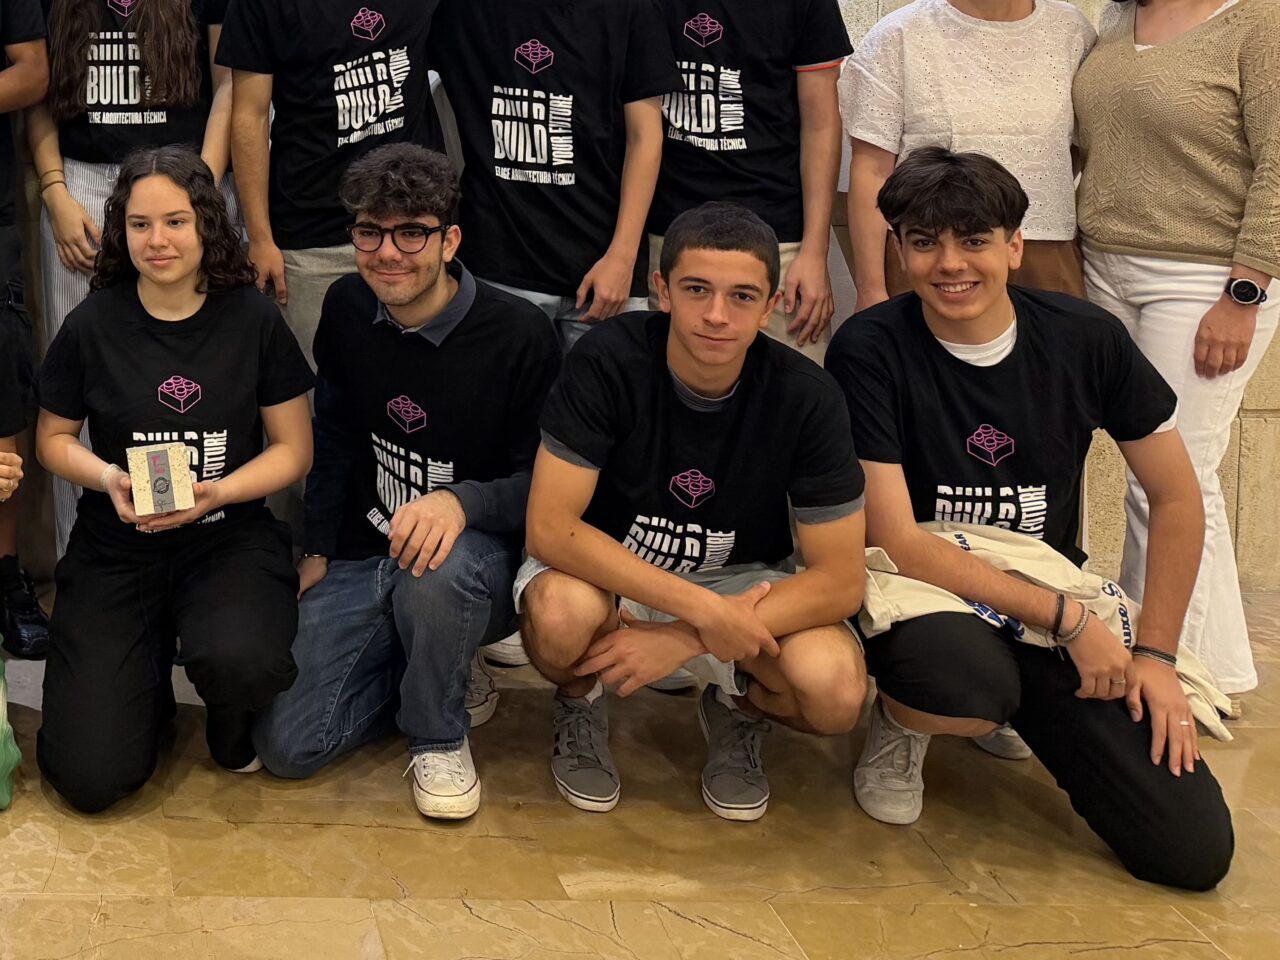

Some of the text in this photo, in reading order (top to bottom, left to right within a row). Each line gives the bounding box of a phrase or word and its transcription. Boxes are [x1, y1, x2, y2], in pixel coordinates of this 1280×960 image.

[87, 66, 141, 105] BUILD
[102, 112, 142, 124] ARQUITECTURA
[143, 109, 167, 124] TÉCNICA
[549, 92, 574, 166] YOUR FUTURE
[720, 103, 744, 132] YOUR
[491, 119, 548, 164] BUILD
[719, 136, 747, 151] TÉCNICA
[203, 429, 227, 478] FUTURE
[1017, 485, 1047, 532] FUTURE
